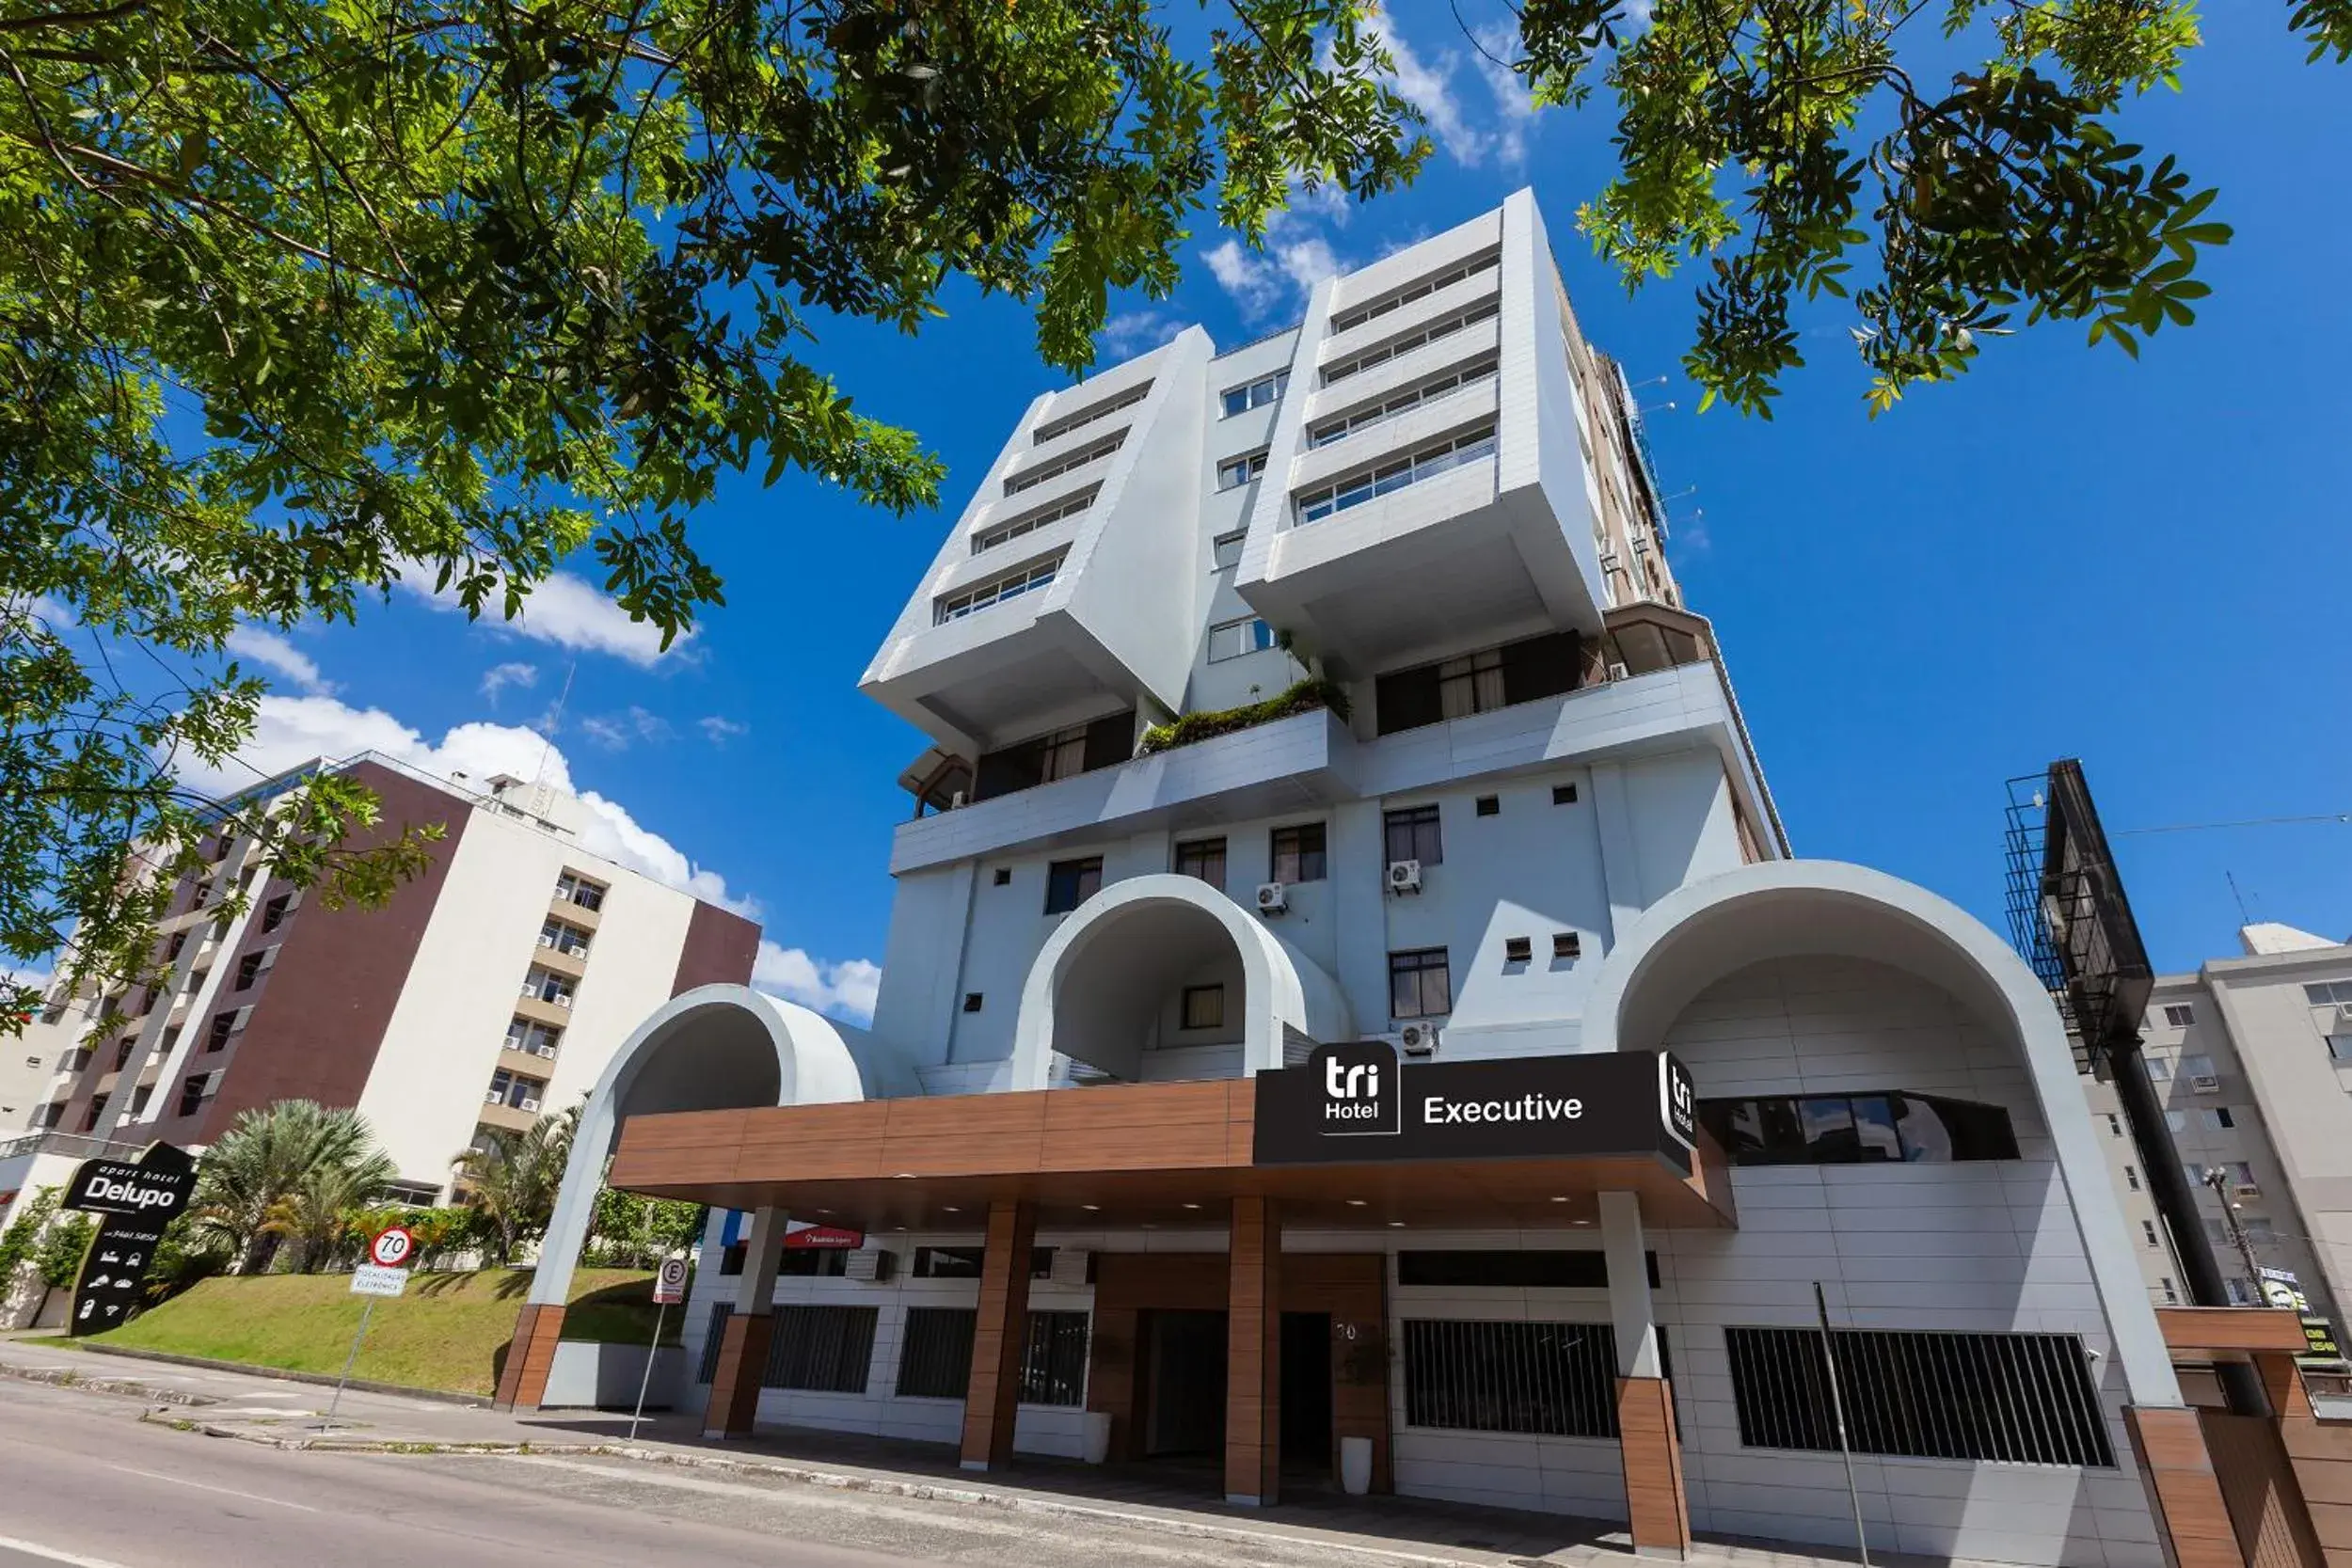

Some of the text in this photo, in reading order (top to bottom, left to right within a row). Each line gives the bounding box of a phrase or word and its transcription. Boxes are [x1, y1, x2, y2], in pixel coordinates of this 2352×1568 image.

[1326, 1056, 1378, 1099] tri
[1672, 1065, 1691, 1115] tri
[1326, 1101, 1378, 1119] Hotel
[1424, 1093, 1583, 1124] Executive
[1675, 1104, 1692, 1132] Hotel
[98, 1165, 182, 1184] apart hotel
[85, 1177, 175, 1210] Delupo
[383, 1235, 405, 1254] 70
[669, 1264, 679, 1279] E
